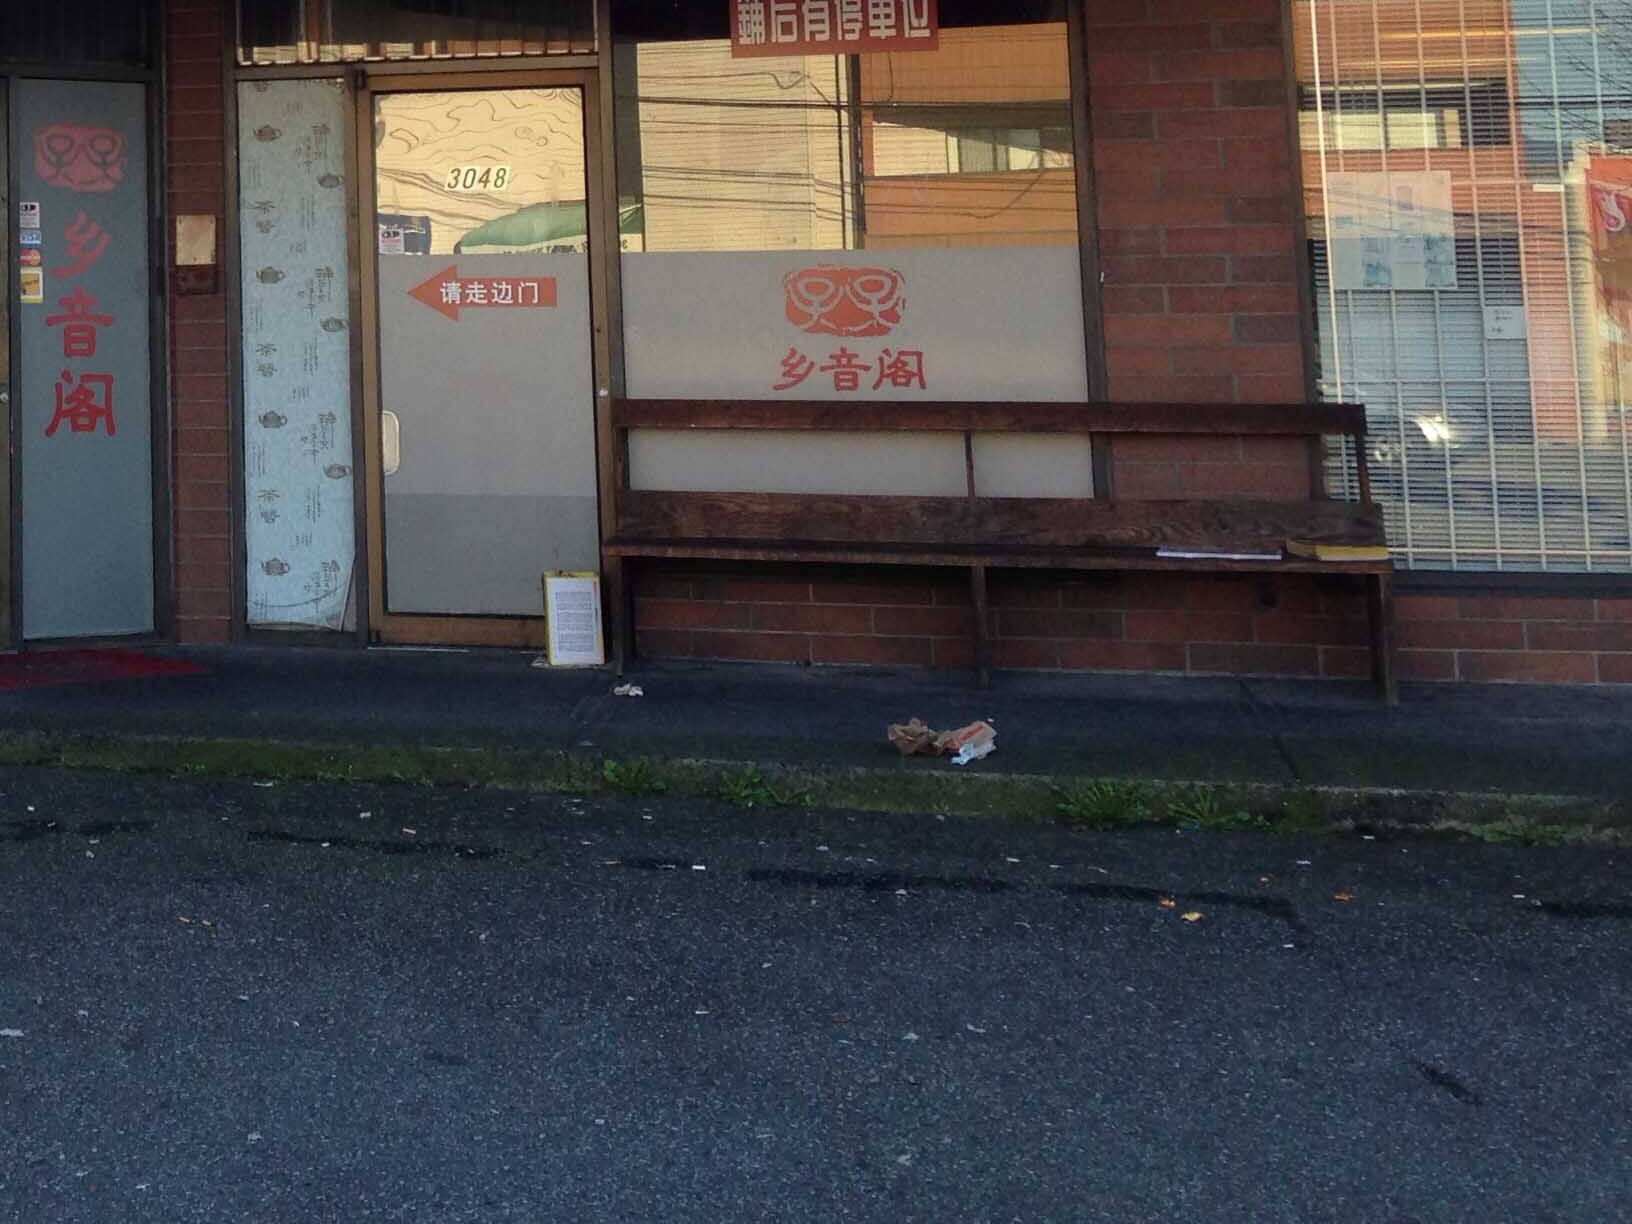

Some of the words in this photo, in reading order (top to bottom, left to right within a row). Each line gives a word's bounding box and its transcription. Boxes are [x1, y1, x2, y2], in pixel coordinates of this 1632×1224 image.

[447, 168, 507, 189] 3048
[440, 281, 539, 304] 请走边门
[45, 210, 116, 437] 乡音阁
[773, 346, 926, 391] 乡音阁
